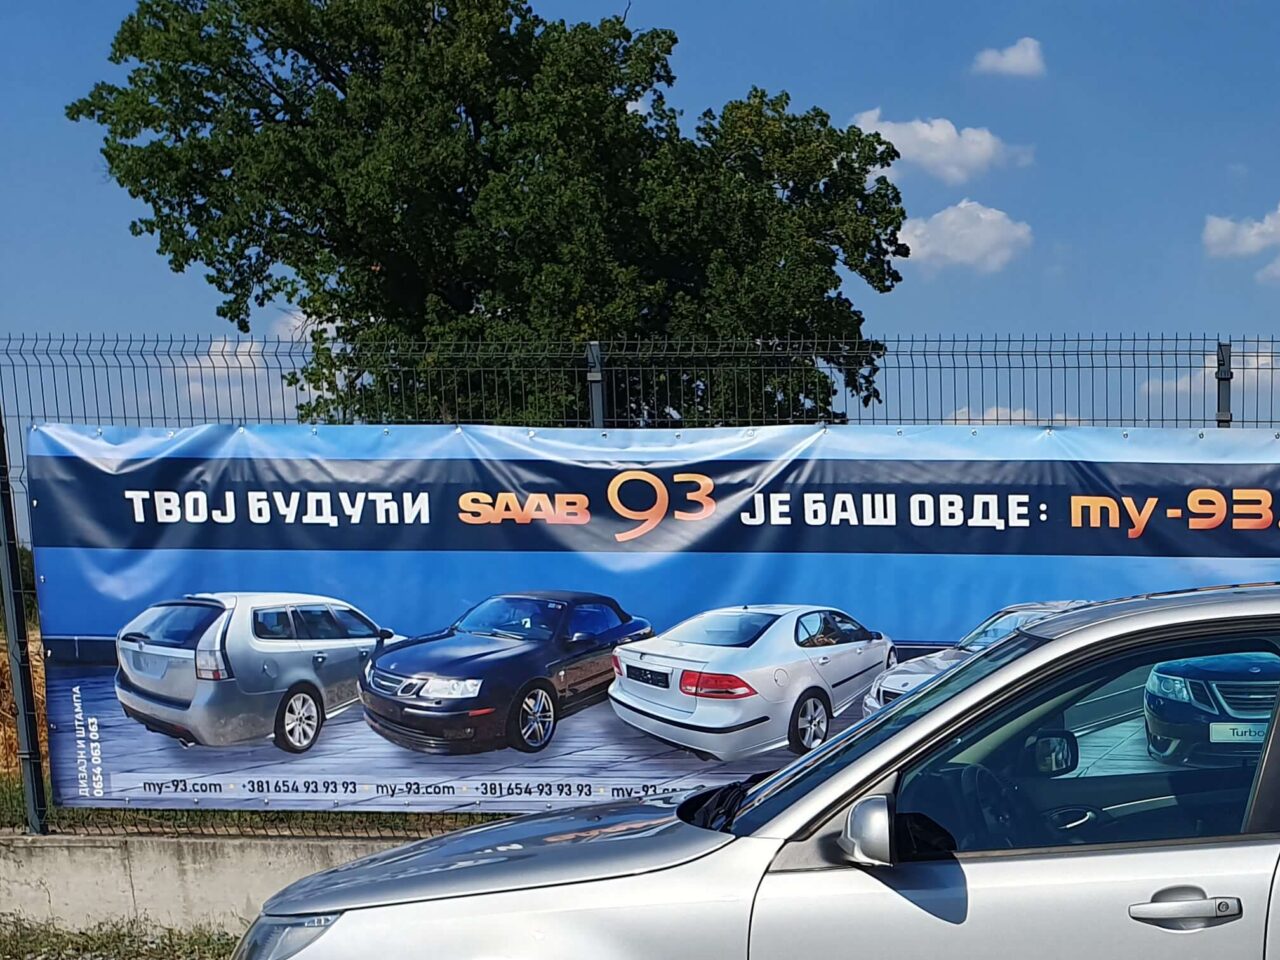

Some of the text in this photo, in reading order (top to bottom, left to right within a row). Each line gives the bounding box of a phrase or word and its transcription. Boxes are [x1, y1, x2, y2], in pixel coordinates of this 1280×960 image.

[124, 490, 236, 523] ТВОЈ
[248, 491, 430, 527] БУДУЋИ
[457, 491, 591, 525] SAAB
[607, 470, 716, 542] 93
[740, 493, 792, 526] ЈЕ
[803, 493, 897, 526] БАШ
[72, 686, 85, 737] ШТАМПА
[1229, 728, 1265, 737] Turbo
[78, 751, 88, 797] ДИЗАЈН
[88, 717, 103, 797] 0654 063 063
[143, 780, 683, 798] my-93.com +381 654 93 93 93 my-93.com +381 654 93 93 93 my-93
